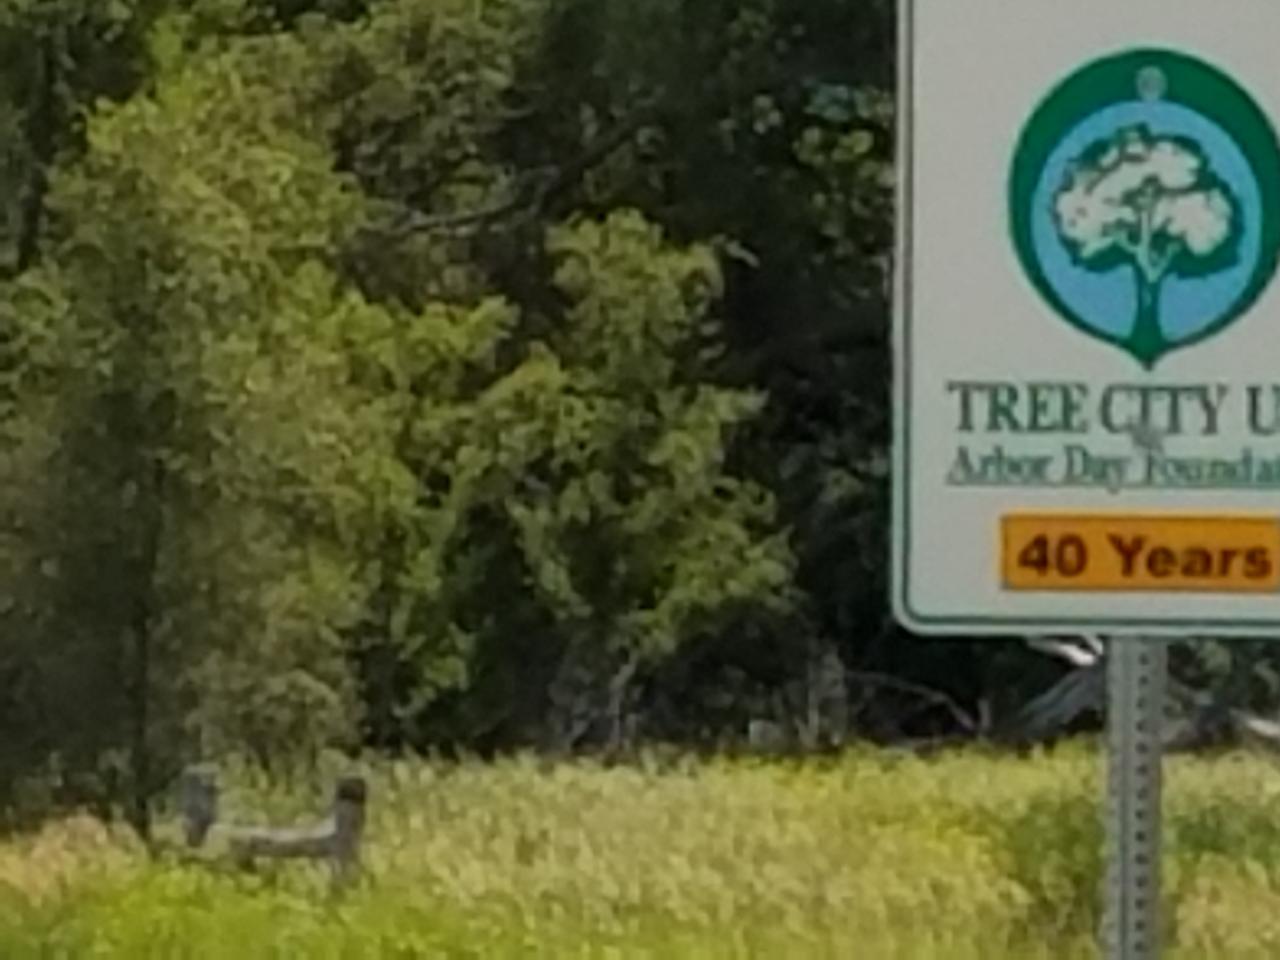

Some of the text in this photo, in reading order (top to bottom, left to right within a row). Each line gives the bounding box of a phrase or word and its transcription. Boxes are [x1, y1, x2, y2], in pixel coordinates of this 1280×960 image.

[946, 381, 1088, 434] TREE
[1098, 384, 1229, 437] CITY
[946, 444, 1052, 486] Arbor
[1064, 445, 1129, 494] Day
[1017, 533, 1273, 579] 40 Years
